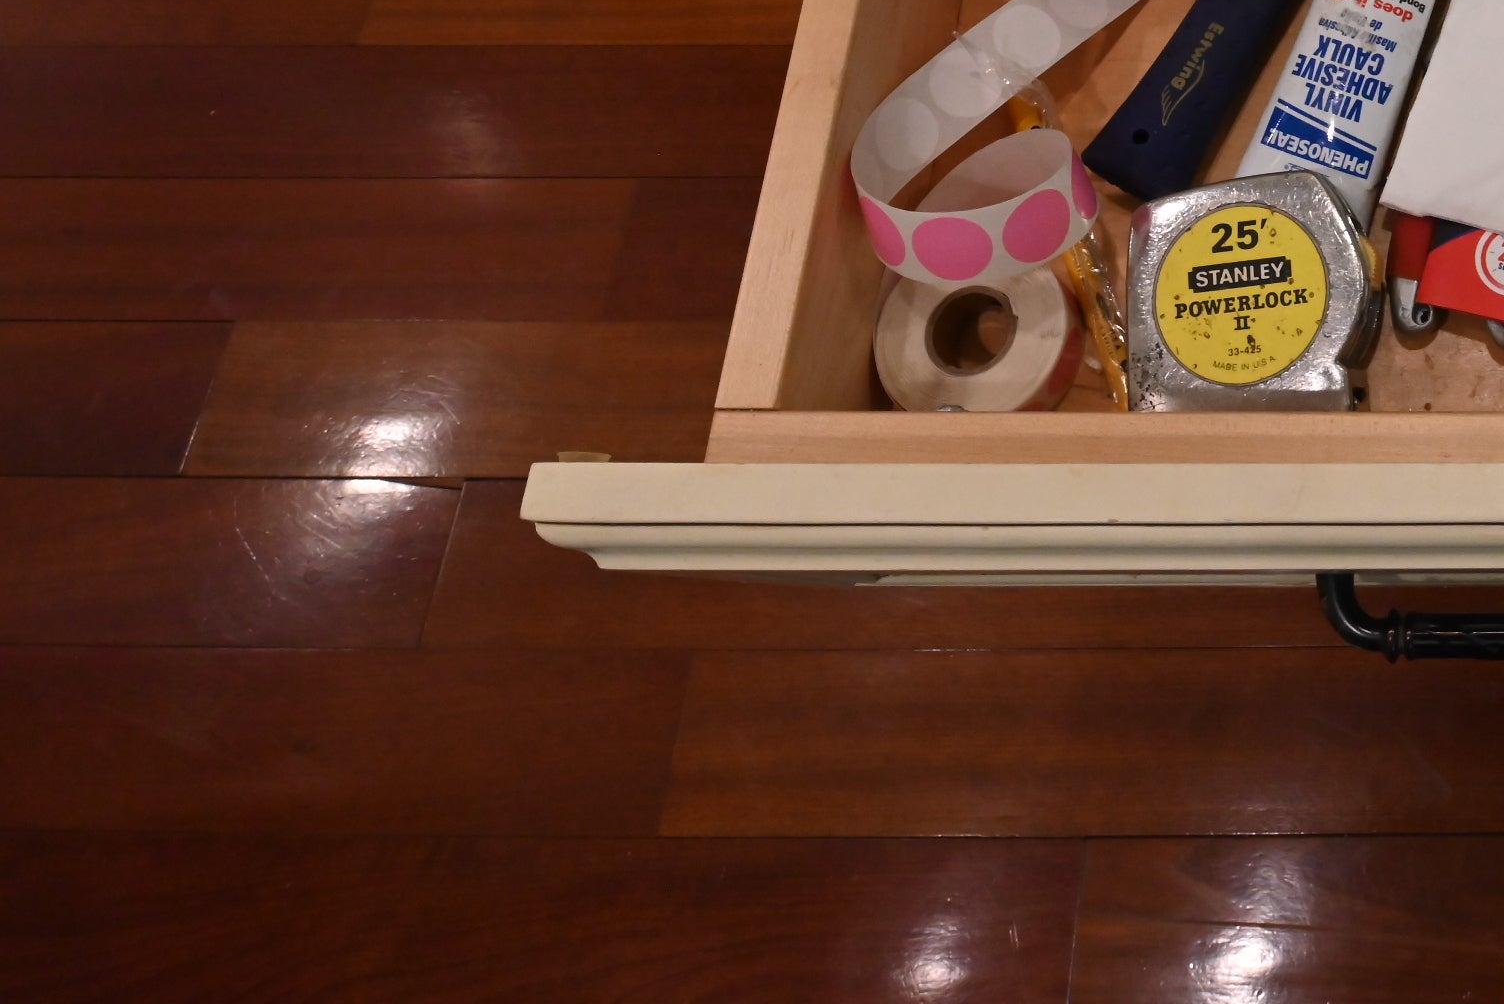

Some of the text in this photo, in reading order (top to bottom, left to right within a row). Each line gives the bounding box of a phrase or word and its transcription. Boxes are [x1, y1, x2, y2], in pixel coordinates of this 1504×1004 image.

[1370, 19, 1382, 31] de
[1373, 0, 1414, 22] does
[1170, 22, 1224, 90] Estwing
[1313, 34, 1385, 76] CAULK
[1292, 54, 1394, 106] ADHESIVE
[1304, 82, 1363, 123] VINYL
[1267, 128, 1370, 173] PHENOSEAL
[1210, 218, 1268, 254] 25'
[1195, 261, 1285, 288] STANLEY
[1174, 288, 1309, 320] POWERLOCK
[1234, 316, 1251, 331] II
[1228, 344, 1262, 357] 33-425
[1240, 361, 1250, 371] IN
